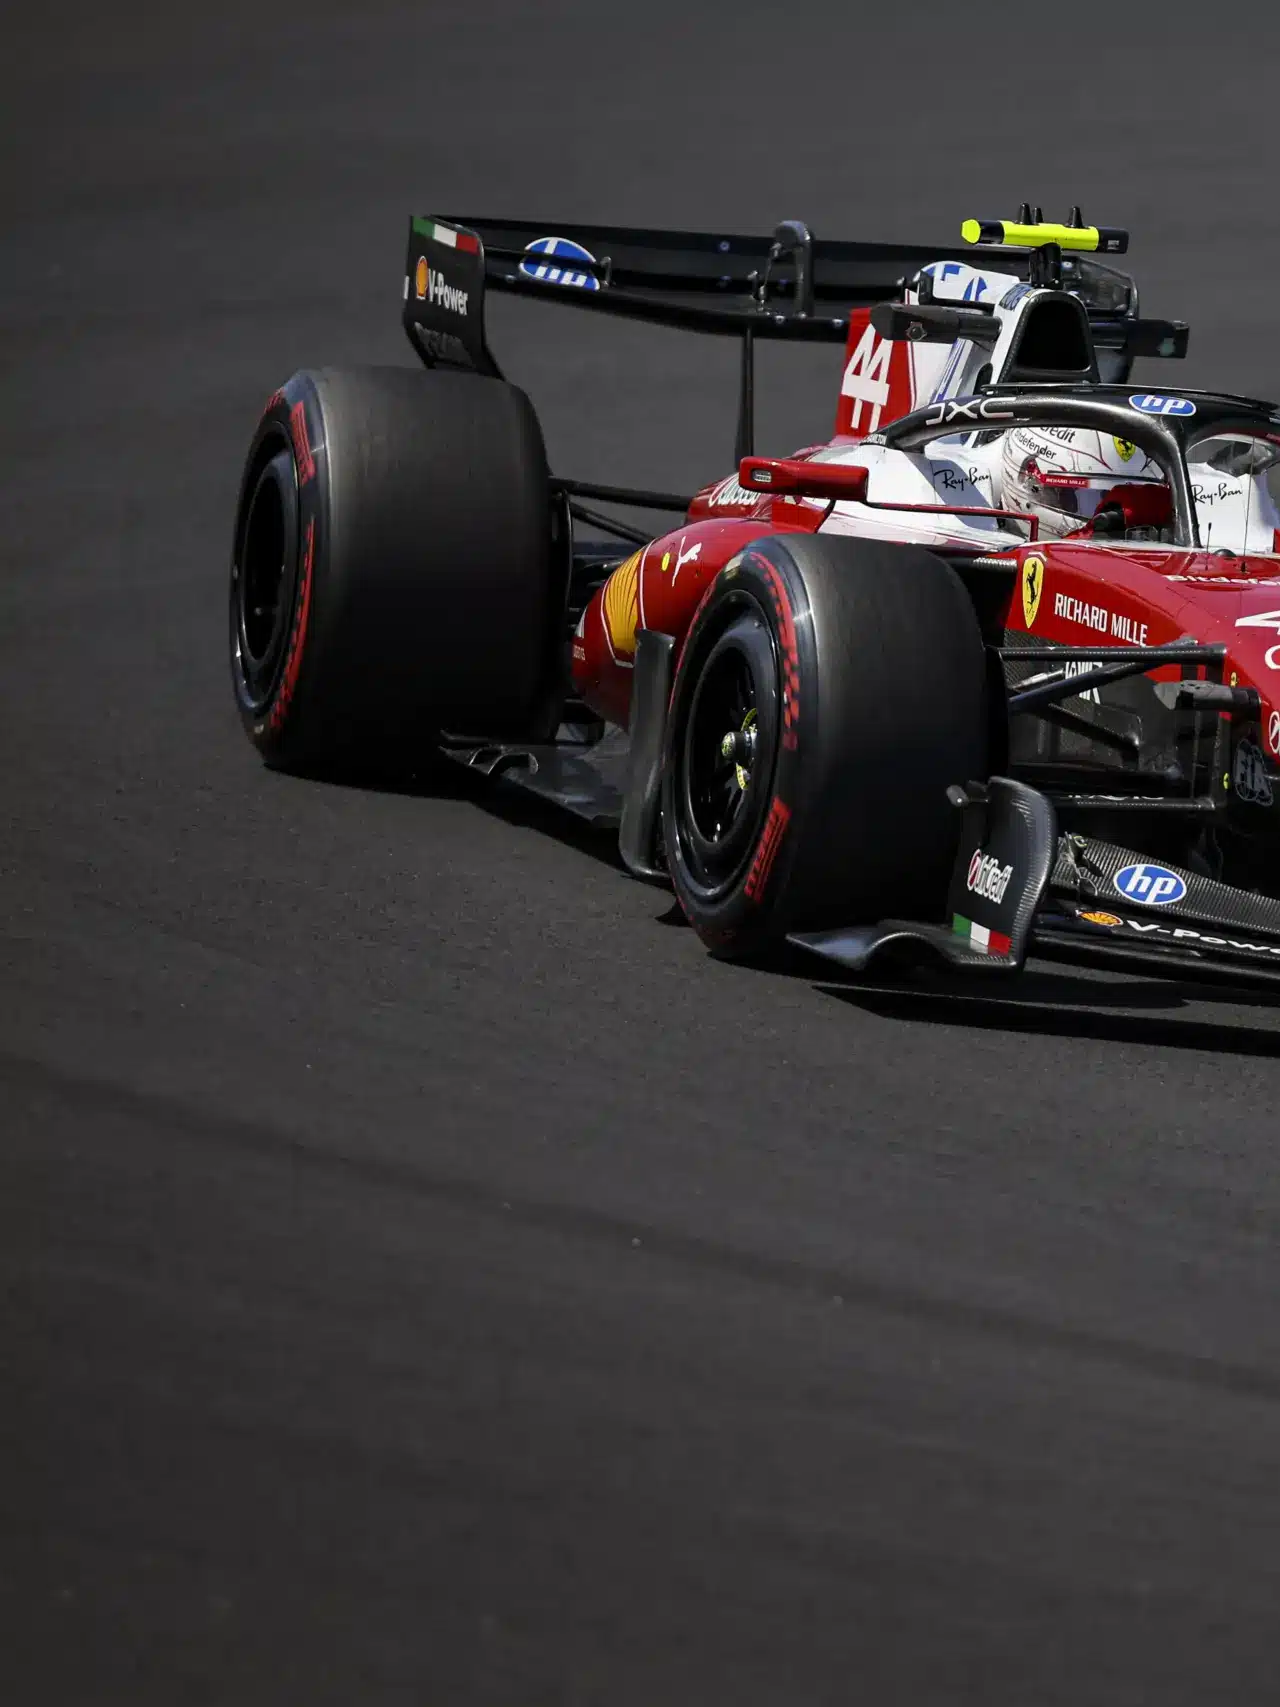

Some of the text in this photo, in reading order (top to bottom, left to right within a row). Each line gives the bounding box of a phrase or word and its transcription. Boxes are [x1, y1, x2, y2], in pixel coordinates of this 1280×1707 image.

[427, 267, 469, 316] V-Power
[841, 323, 891, 433] 44
[1140, 394, 1187, 415] hp
[1054, 592, 1148, 648] RICHARD MILLE
[1125, 865, 1178, 903] hp
